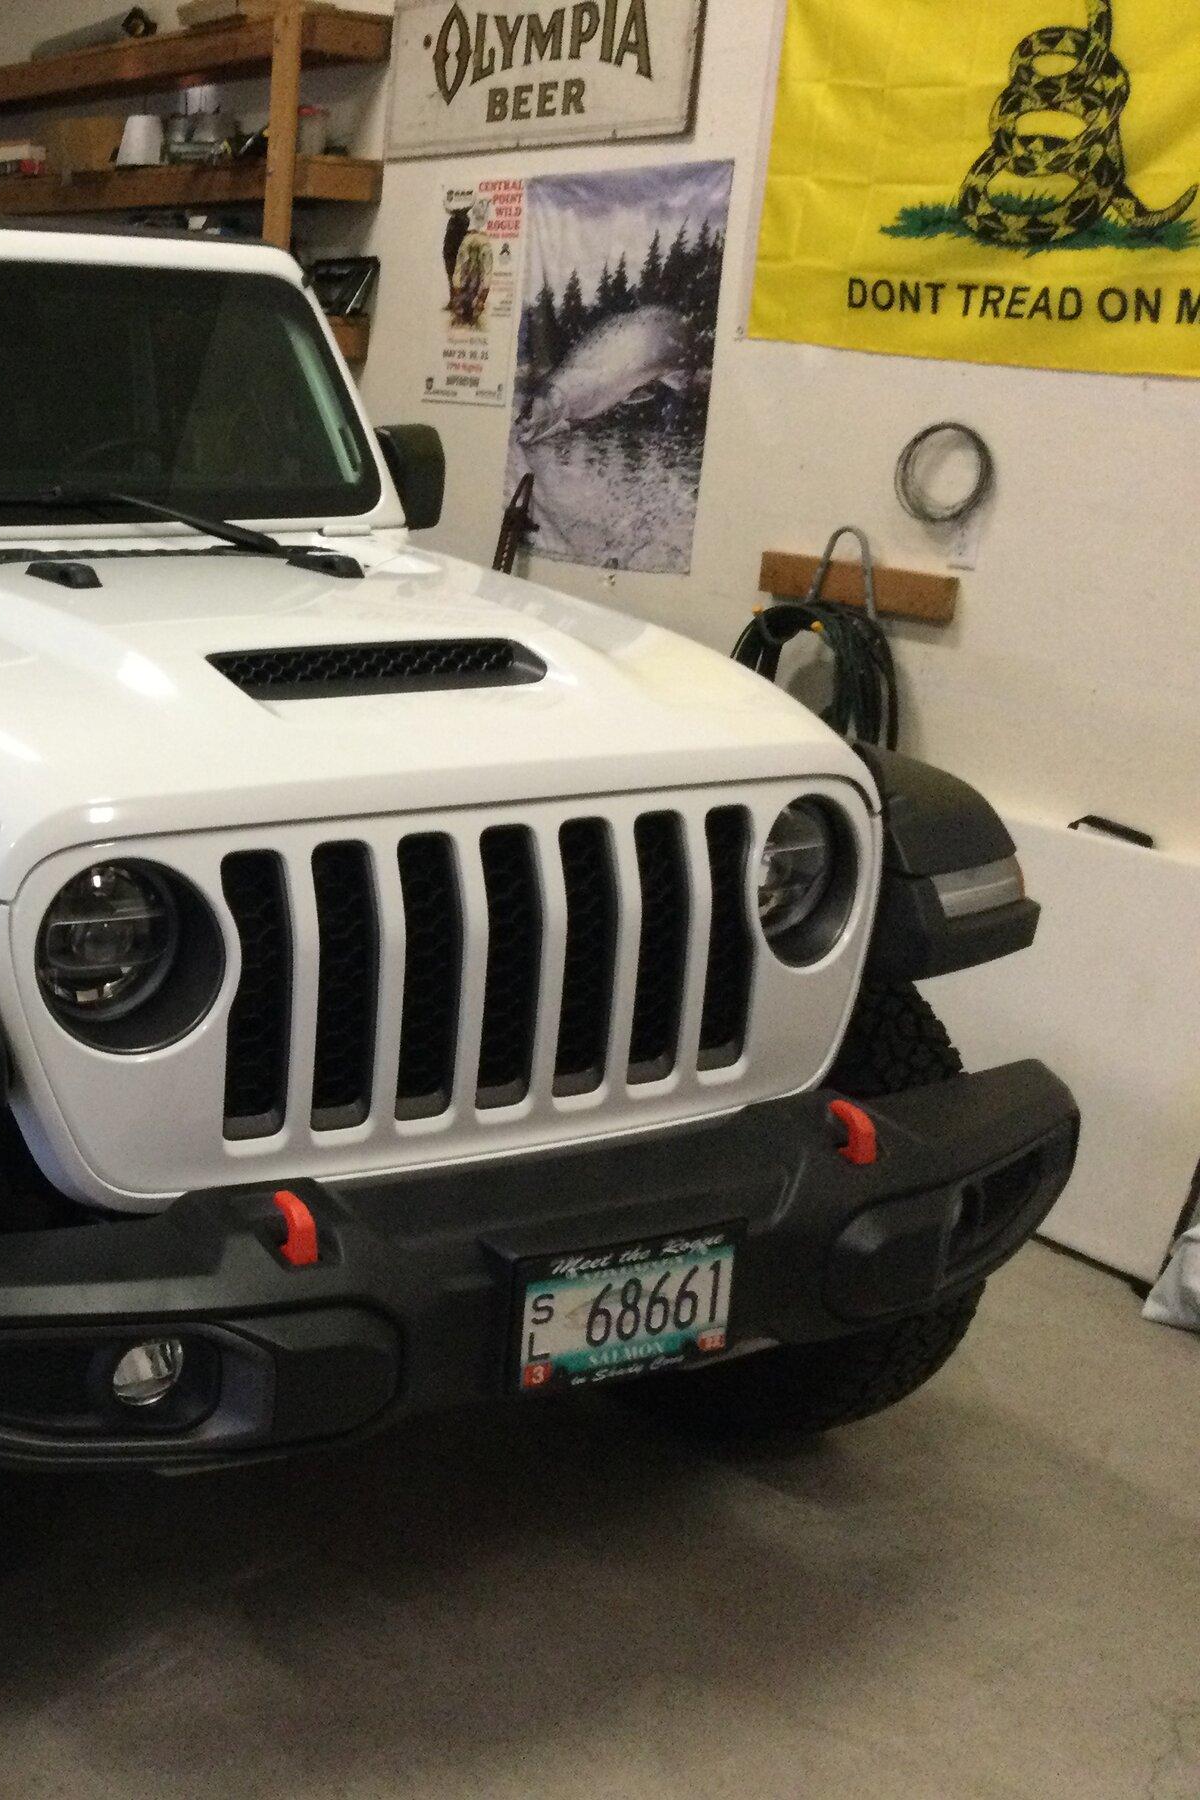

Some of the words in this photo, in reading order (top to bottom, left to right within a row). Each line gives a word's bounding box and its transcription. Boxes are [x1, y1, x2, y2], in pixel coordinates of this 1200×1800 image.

[432, 0, 653, 106] OLYMPIA
[485, 77, 586, 123] BEER
[478, 180, 524, 193] CENTRAL
[492, 193, 523, 205] POINT
[486, 219, 521, 231] ROGUE
[495, 206, 522, 217] WILD
[847, 277, 946, 314] DONT
[956, 283, 1083, 321] TREAD
[1098, 287, 1162, 324] ON
[552, 1254, 615, 1276] Meet
[619, 1245, 652, 1263] the
[585, 1259, 722, 1348] 68661
[588, 1342, 666, 1366] SALMON
